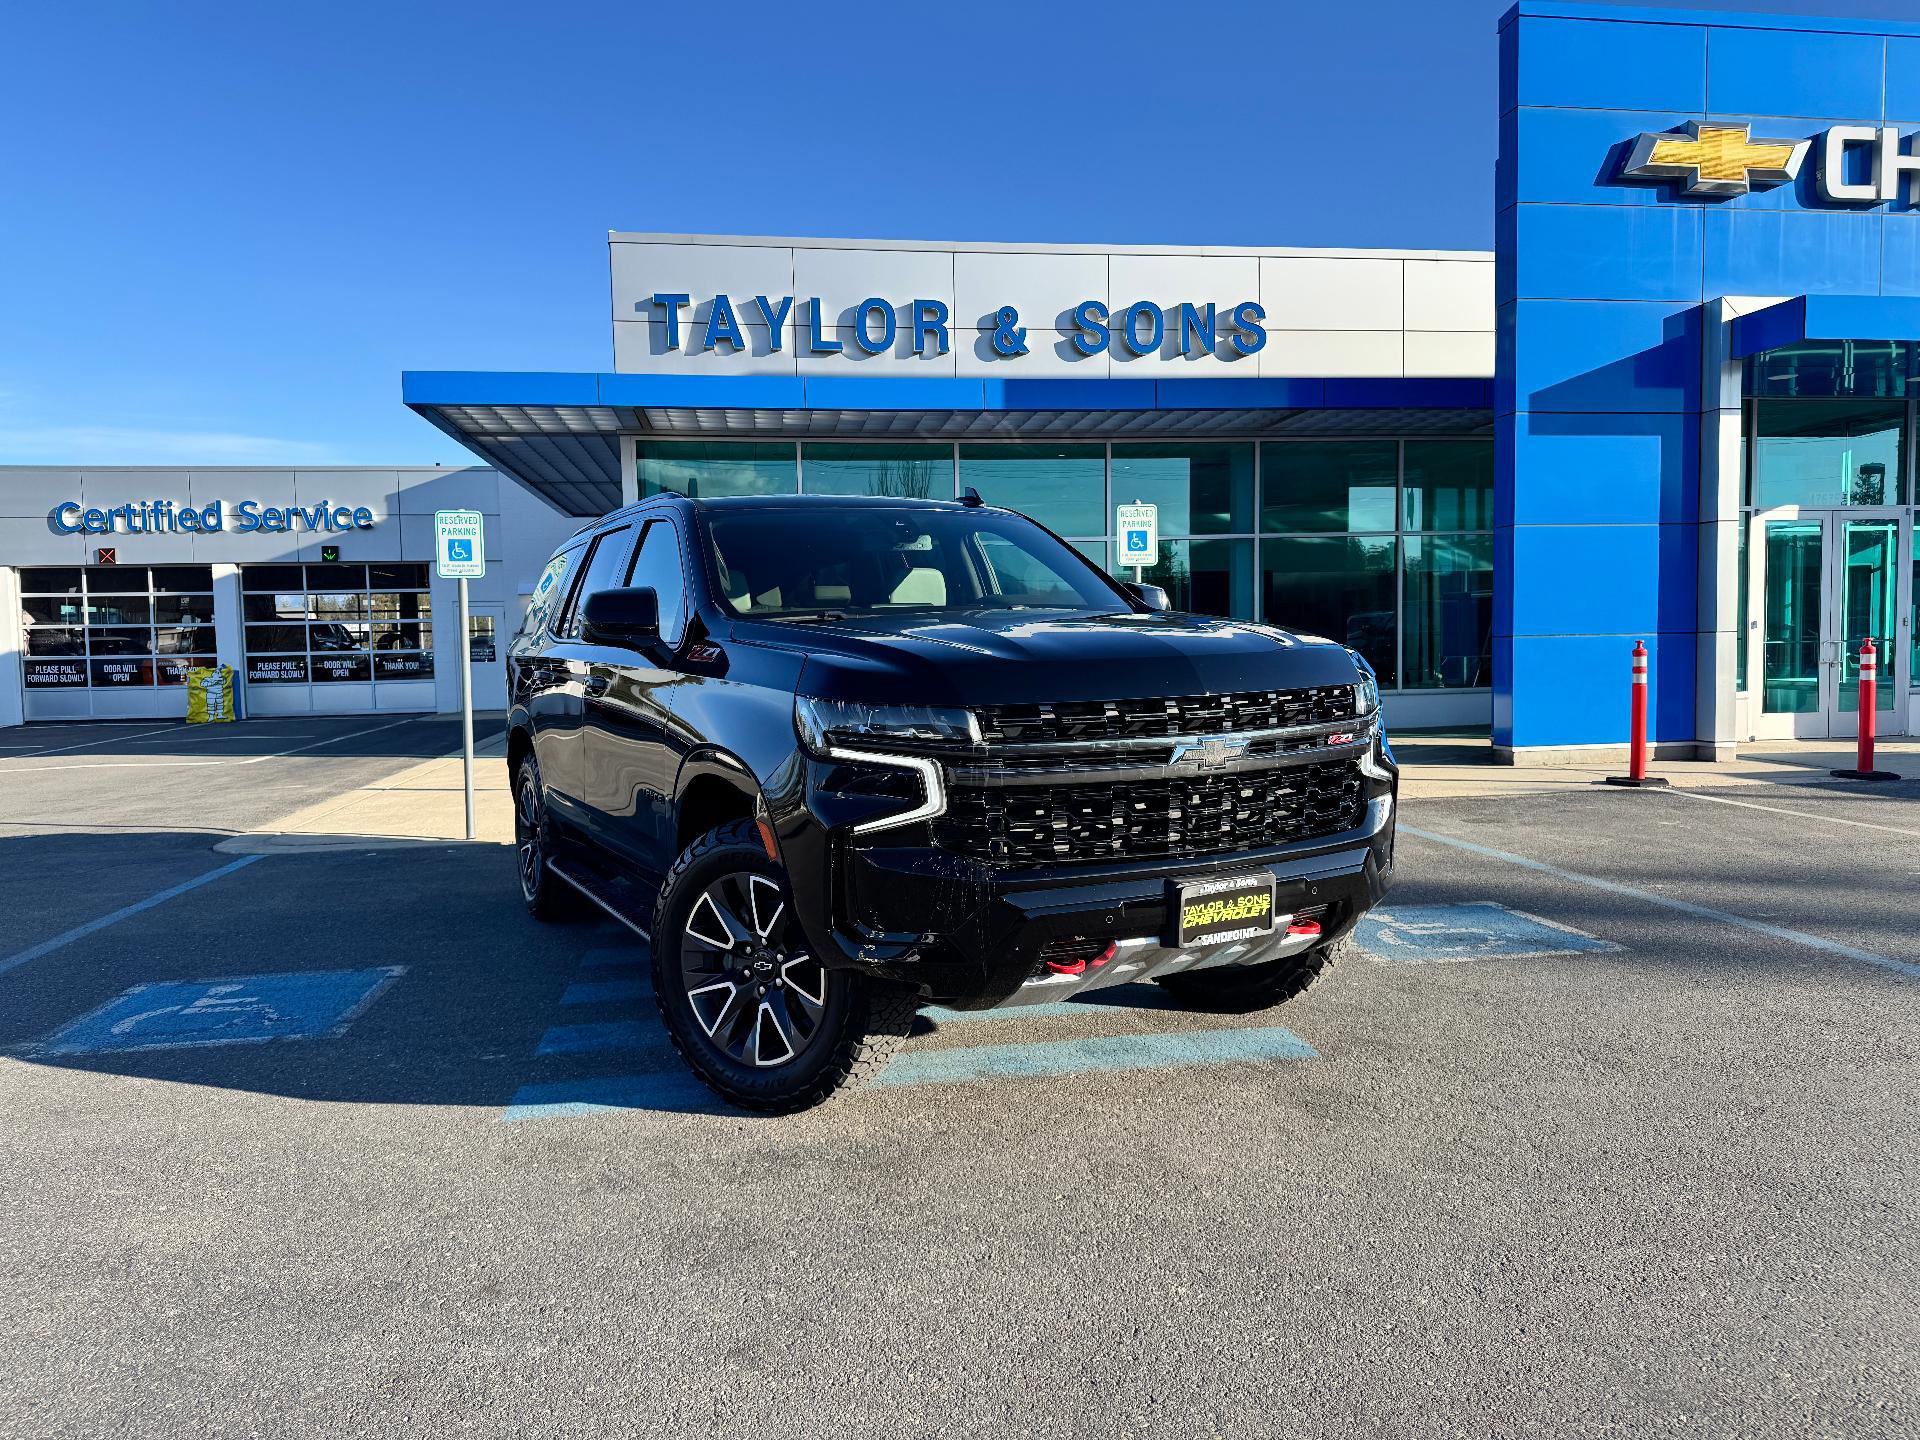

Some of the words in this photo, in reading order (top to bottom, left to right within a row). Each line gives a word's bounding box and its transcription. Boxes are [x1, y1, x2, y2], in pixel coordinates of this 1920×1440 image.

[653, 293, 950, 354] TAYLOR
[993, 305, 1030, 354] &
[1075, 301, 1267, 354] SONS
[55, 500, 222, 533] Certified
[238, 500, 373, 531] Service
[1120, 510, 1154, 518] RESERVED
[440, 516, 478, 525] RESERVED
[1122, 520, 1152, 528] PARKING
[441, 527, 477, 536] PARKING
[103, 664, 121, 673] DOOR
[122, 664, 138, 673] WILL
[257, 661, 281, 671] PLEASE
[281, 661, 297, 670] PULL
[323, 660, 341, 669] DOOR
[341, 660, 358, 669] WILL
[384, 661, 403, 671] THANK
[36, 665, 59, 674] PLEASE
[60, 665, 77, 674] PULL
[332, 668, 349, 678] OPEN
[27, 674, 59, 683] FORWARD
[59, 674, 85, 683] SLOWLY
[112, 673, 130, 682] OPEN
[249, 670, 280, 680] FORWARD
[280, 670, 305, 679] SLOWLY
[1184, 900, 1224, 915] TAYLOR
[1227, 899, 1235, 909] &
[1237, 894, 1271, 907] SONS
[1182, 902, 1271, 928] CHEVROLET
[1201, 928, 1254, 945] SANDPOINT
